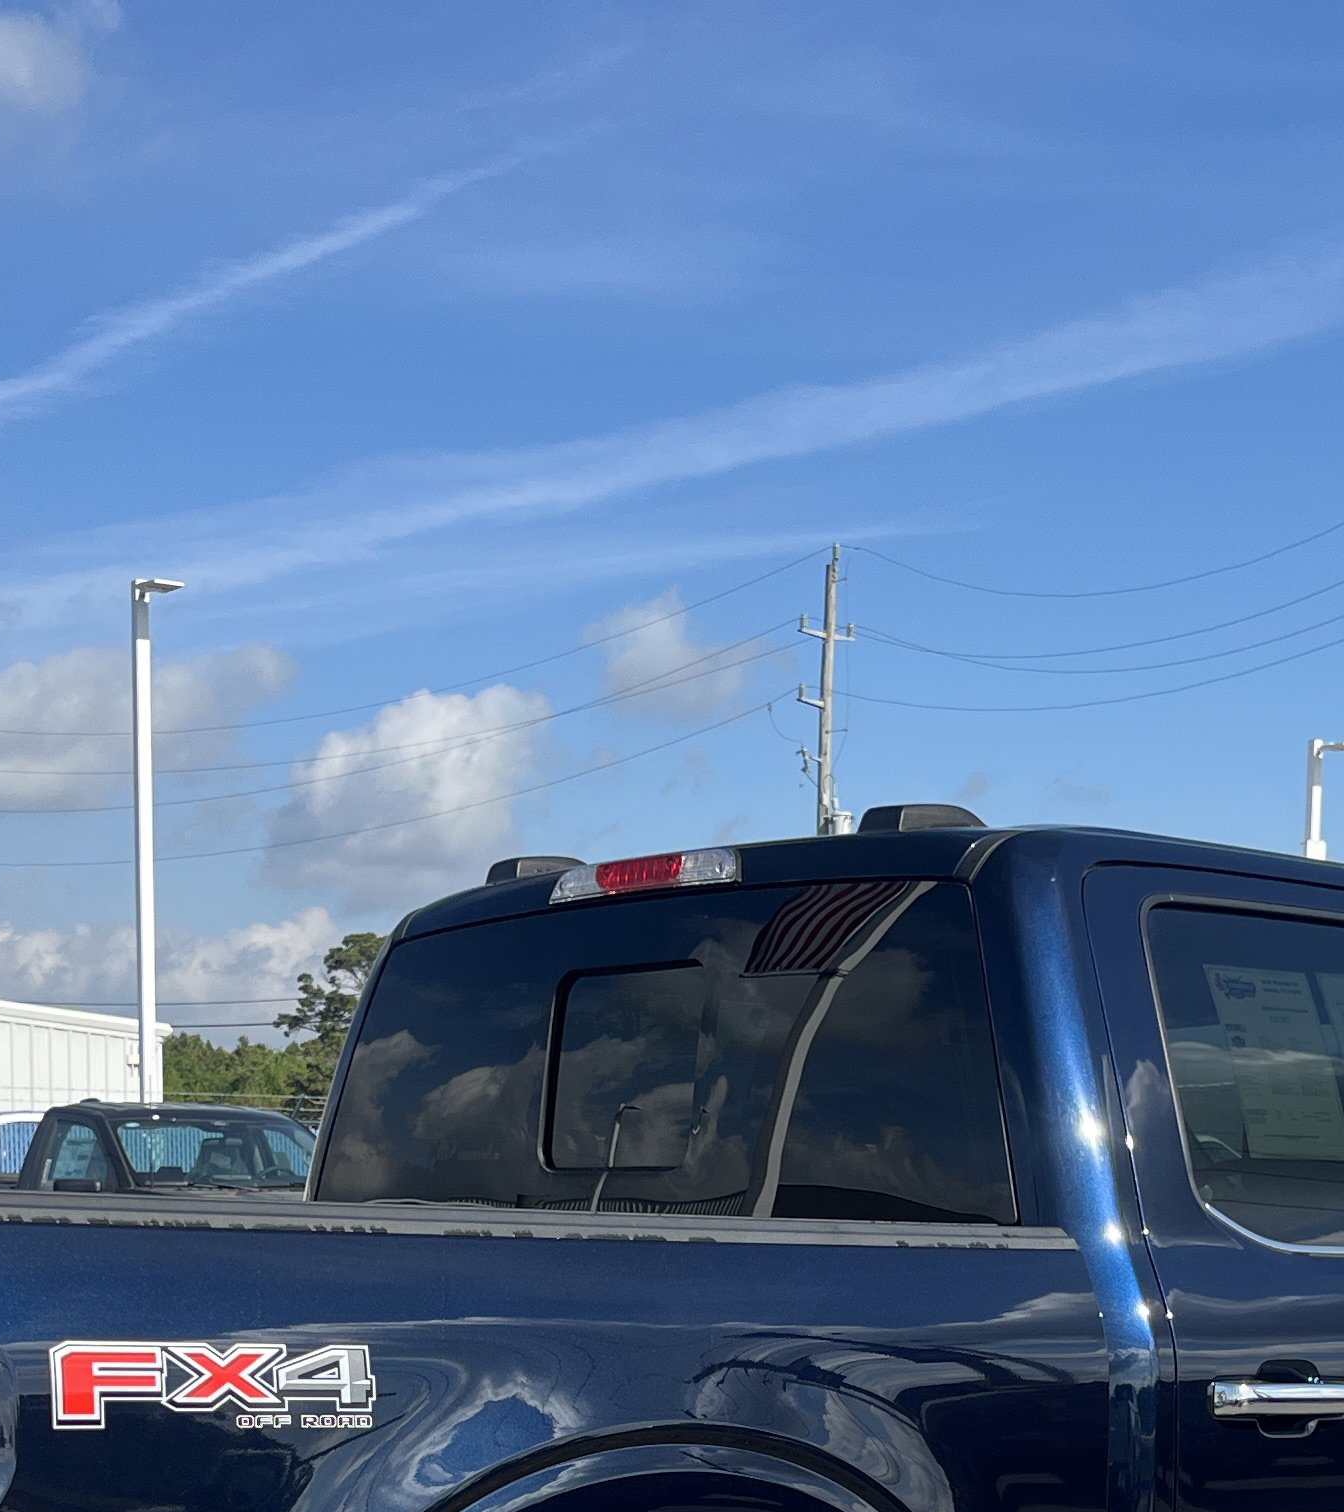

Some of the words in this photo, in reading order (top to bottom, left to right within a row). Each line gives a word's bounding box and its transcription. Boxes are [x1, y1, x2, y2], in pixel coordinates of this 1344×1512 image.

[49, 1340, 377, 1429] FX4
[236, 1414, 292, 1429] OFF
[301, 1414, 373, 1429] ROAD
